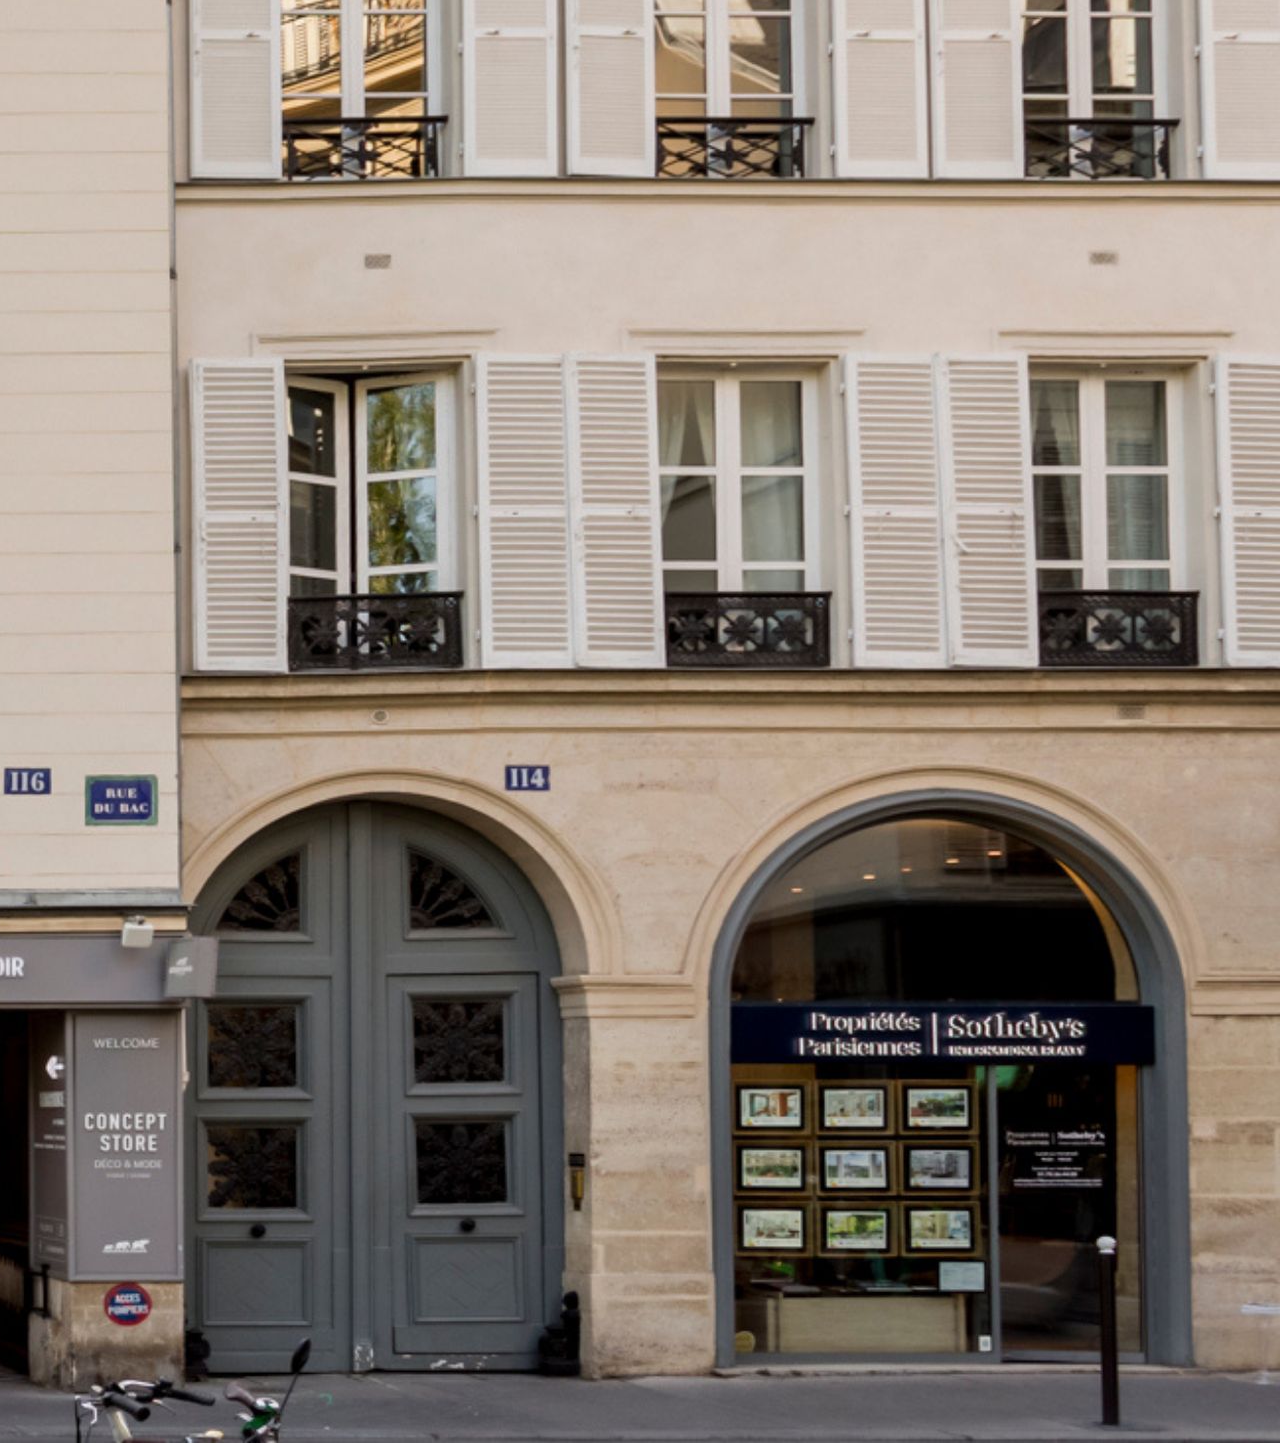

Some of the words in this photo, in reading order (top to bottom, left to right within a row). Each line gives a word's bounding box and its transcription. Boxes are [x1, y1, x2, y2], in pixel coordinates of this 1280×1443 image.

[10, 771, 45, 792] 116
[510, 768, 545, 788] 114
[105, 788, 137, 799] RUE
[94, 803, 114, 814] DU
[119, 803, 149, 814] BAC
[811, 1012, 921, 1034] Propriétés
[947, 1012, 1086, 1043] Sotheby's
[93, 1038, 160, 1048] WELCOME
[799, 1038, 922, 1056] Parisiennes
[84, 1113, 167, 1130] CONCEPT
[100, 1134, 158, 1151] STORE
